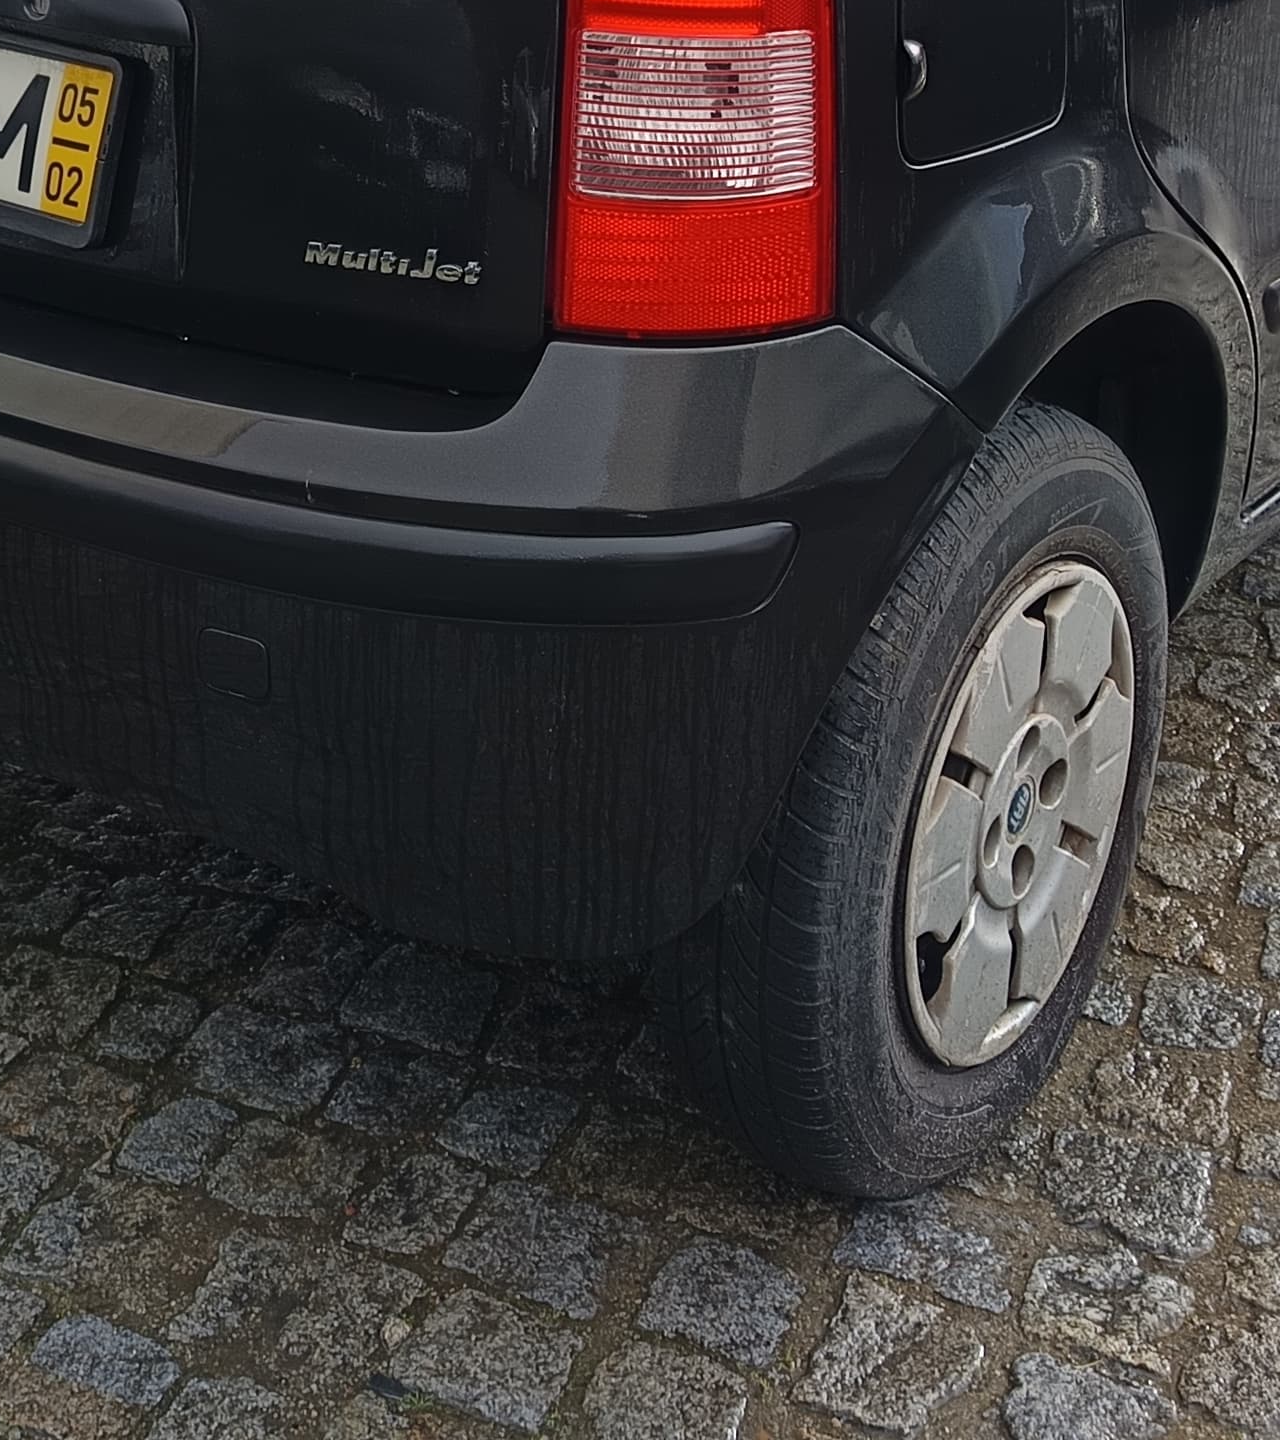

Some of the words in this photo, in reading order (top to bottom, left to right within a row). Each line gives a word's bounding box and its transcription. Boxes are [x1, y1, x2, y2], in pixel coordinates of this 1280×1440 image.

[58, 82, 97, 128] 05
[45, 160, 84, 209] 02
[304, 240, 482, 285] MultiJet
